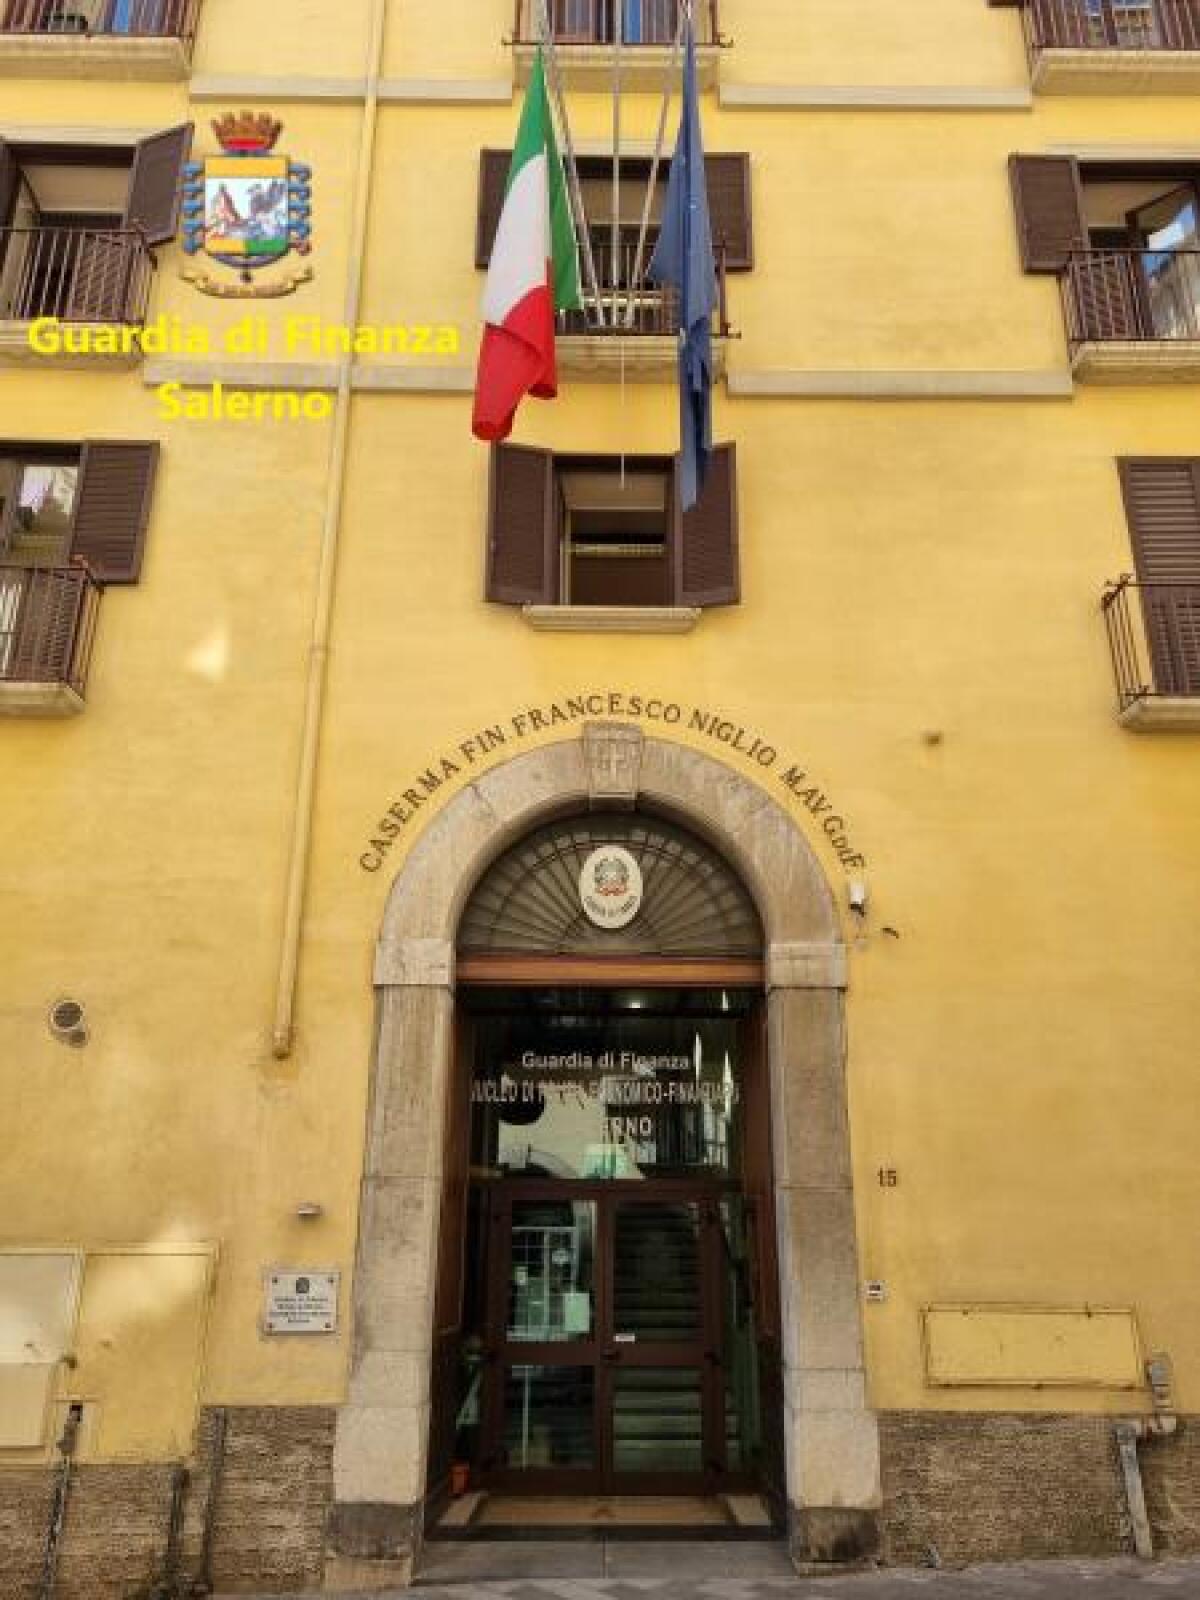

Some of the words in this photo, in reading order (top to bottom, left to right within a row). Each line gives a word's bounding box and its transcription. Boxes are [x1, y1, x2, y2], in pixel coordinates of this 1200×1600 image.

[359, 757, 461, 873] CASERMA
[458, 724, 506, 763] FIN
[511, 692, 682, 737] FRANCESCO
[687, 708, 777, 767] NIGLIO
[522, 1051, 592, 1069] Guardia
[597, 1051, 614, 1069] di
[877, 1167, 897, 1188] 15
